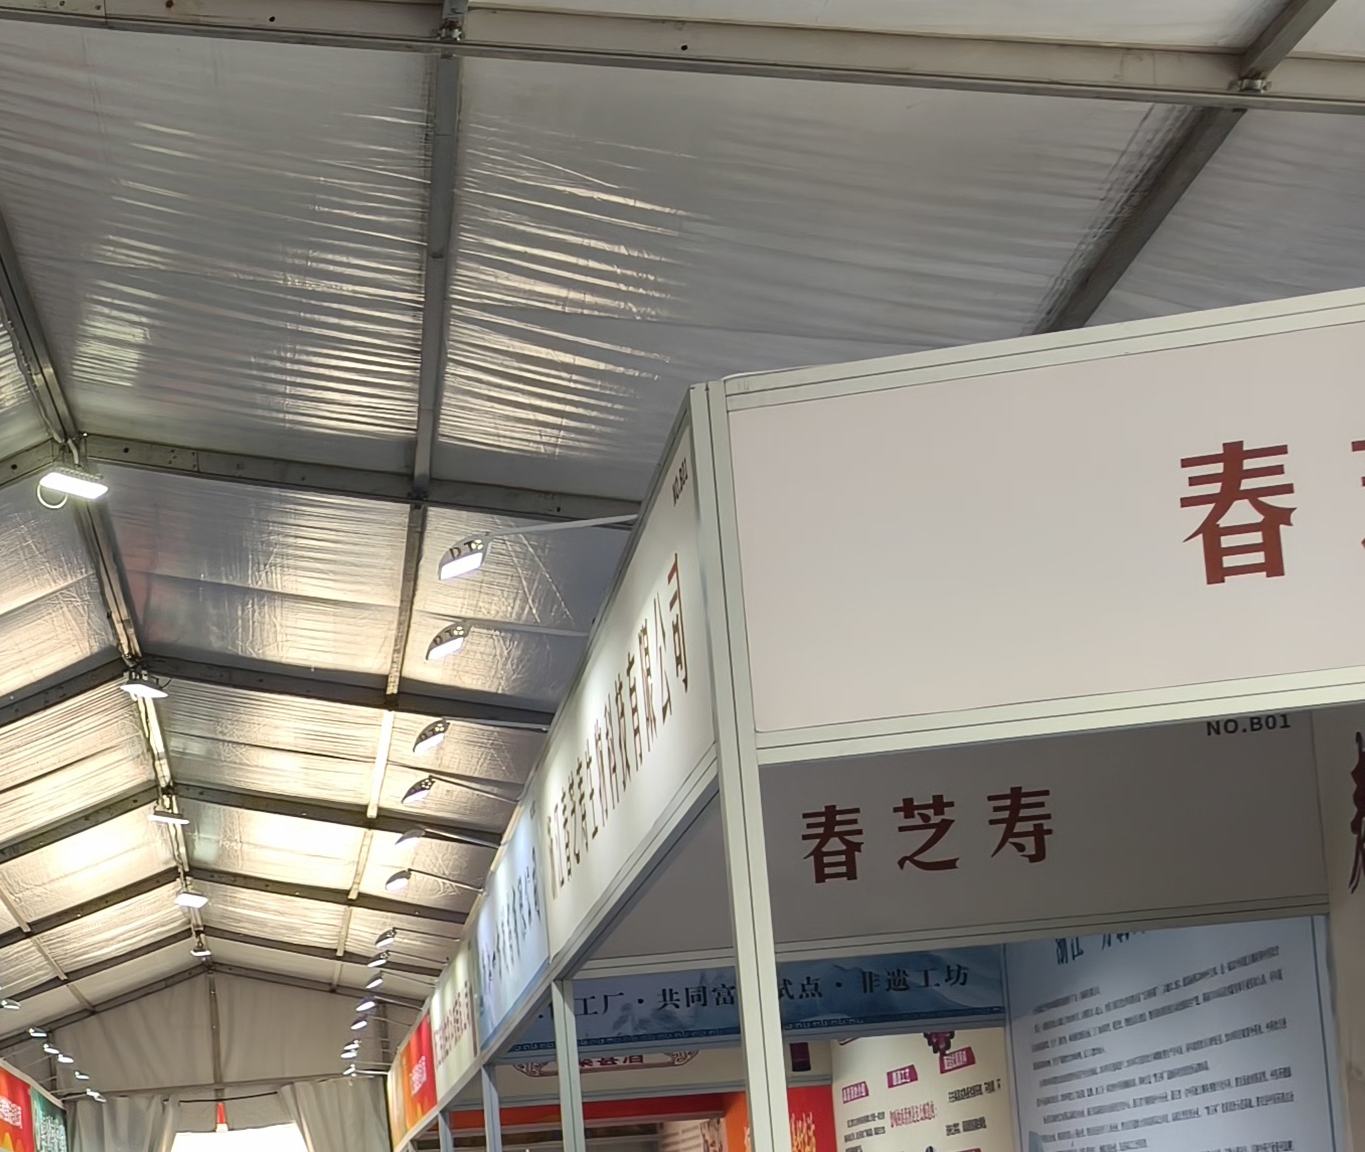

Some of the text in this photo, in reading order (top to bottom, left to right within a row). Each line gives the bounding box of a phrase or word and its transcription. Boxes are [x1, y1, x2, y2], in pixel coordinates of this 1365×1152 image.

[1180, 440, 1365, 586] 春
[1205, 713, 1292, 738] NO.B01
[801, 785, 1054, 884] 春芝寿
